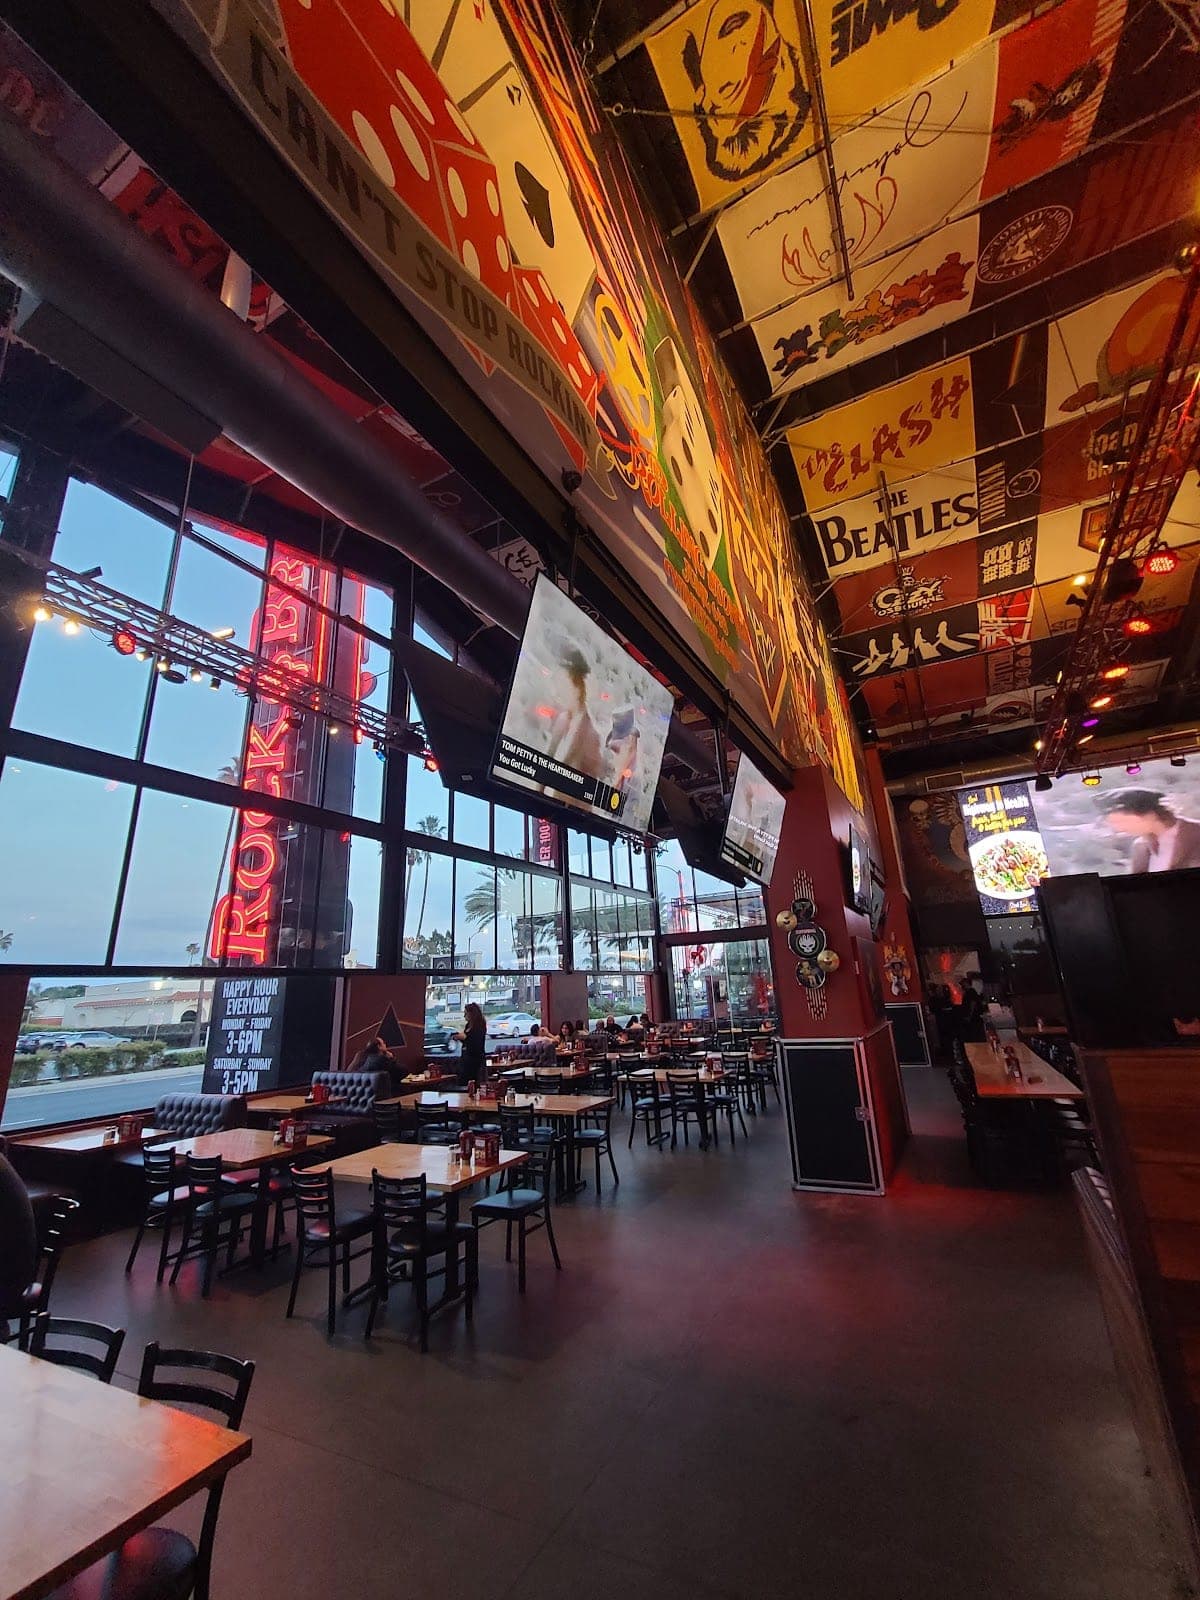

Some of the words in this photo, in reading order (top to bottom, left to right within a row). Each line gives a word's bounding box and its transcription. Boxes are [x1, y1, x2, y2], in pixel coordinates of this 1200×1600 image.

[416, 240, 499, 341] STOP
[823, 375, 969, 492] CLASH
[873, 489, 909, 513] THE
[816, 492, 980, 567] BEATLES
[499, 753, 510, 764] You
[510, 758, 521, 770] Got
[521, 762, 537, 777] Lucky
[502, 740, 516, 754] TOM
[516, 746, 533, 761] PETTY
[532, 754, 538, 764] &
[538, 757, 548, 768] THE
[548, 761, 584, 785] HEARTBREAKERS
[222, 980, 253, 998] HAPPY
[253, 978, 279, 996] HOUR
[226, 997, 271, 1015] EVERYDAY
[221, 1018, 246, 1030] MONDAY
[250, 1017, 272, 1029] FRIDAY
[226, 1030, 263, 1054] 3-6PM
[213, 1058, 242, 1070] SATURDAY
[247, 1058, 272, 1070] SUNDAY
[222, 1071, 258, 1094] 3-5PM
